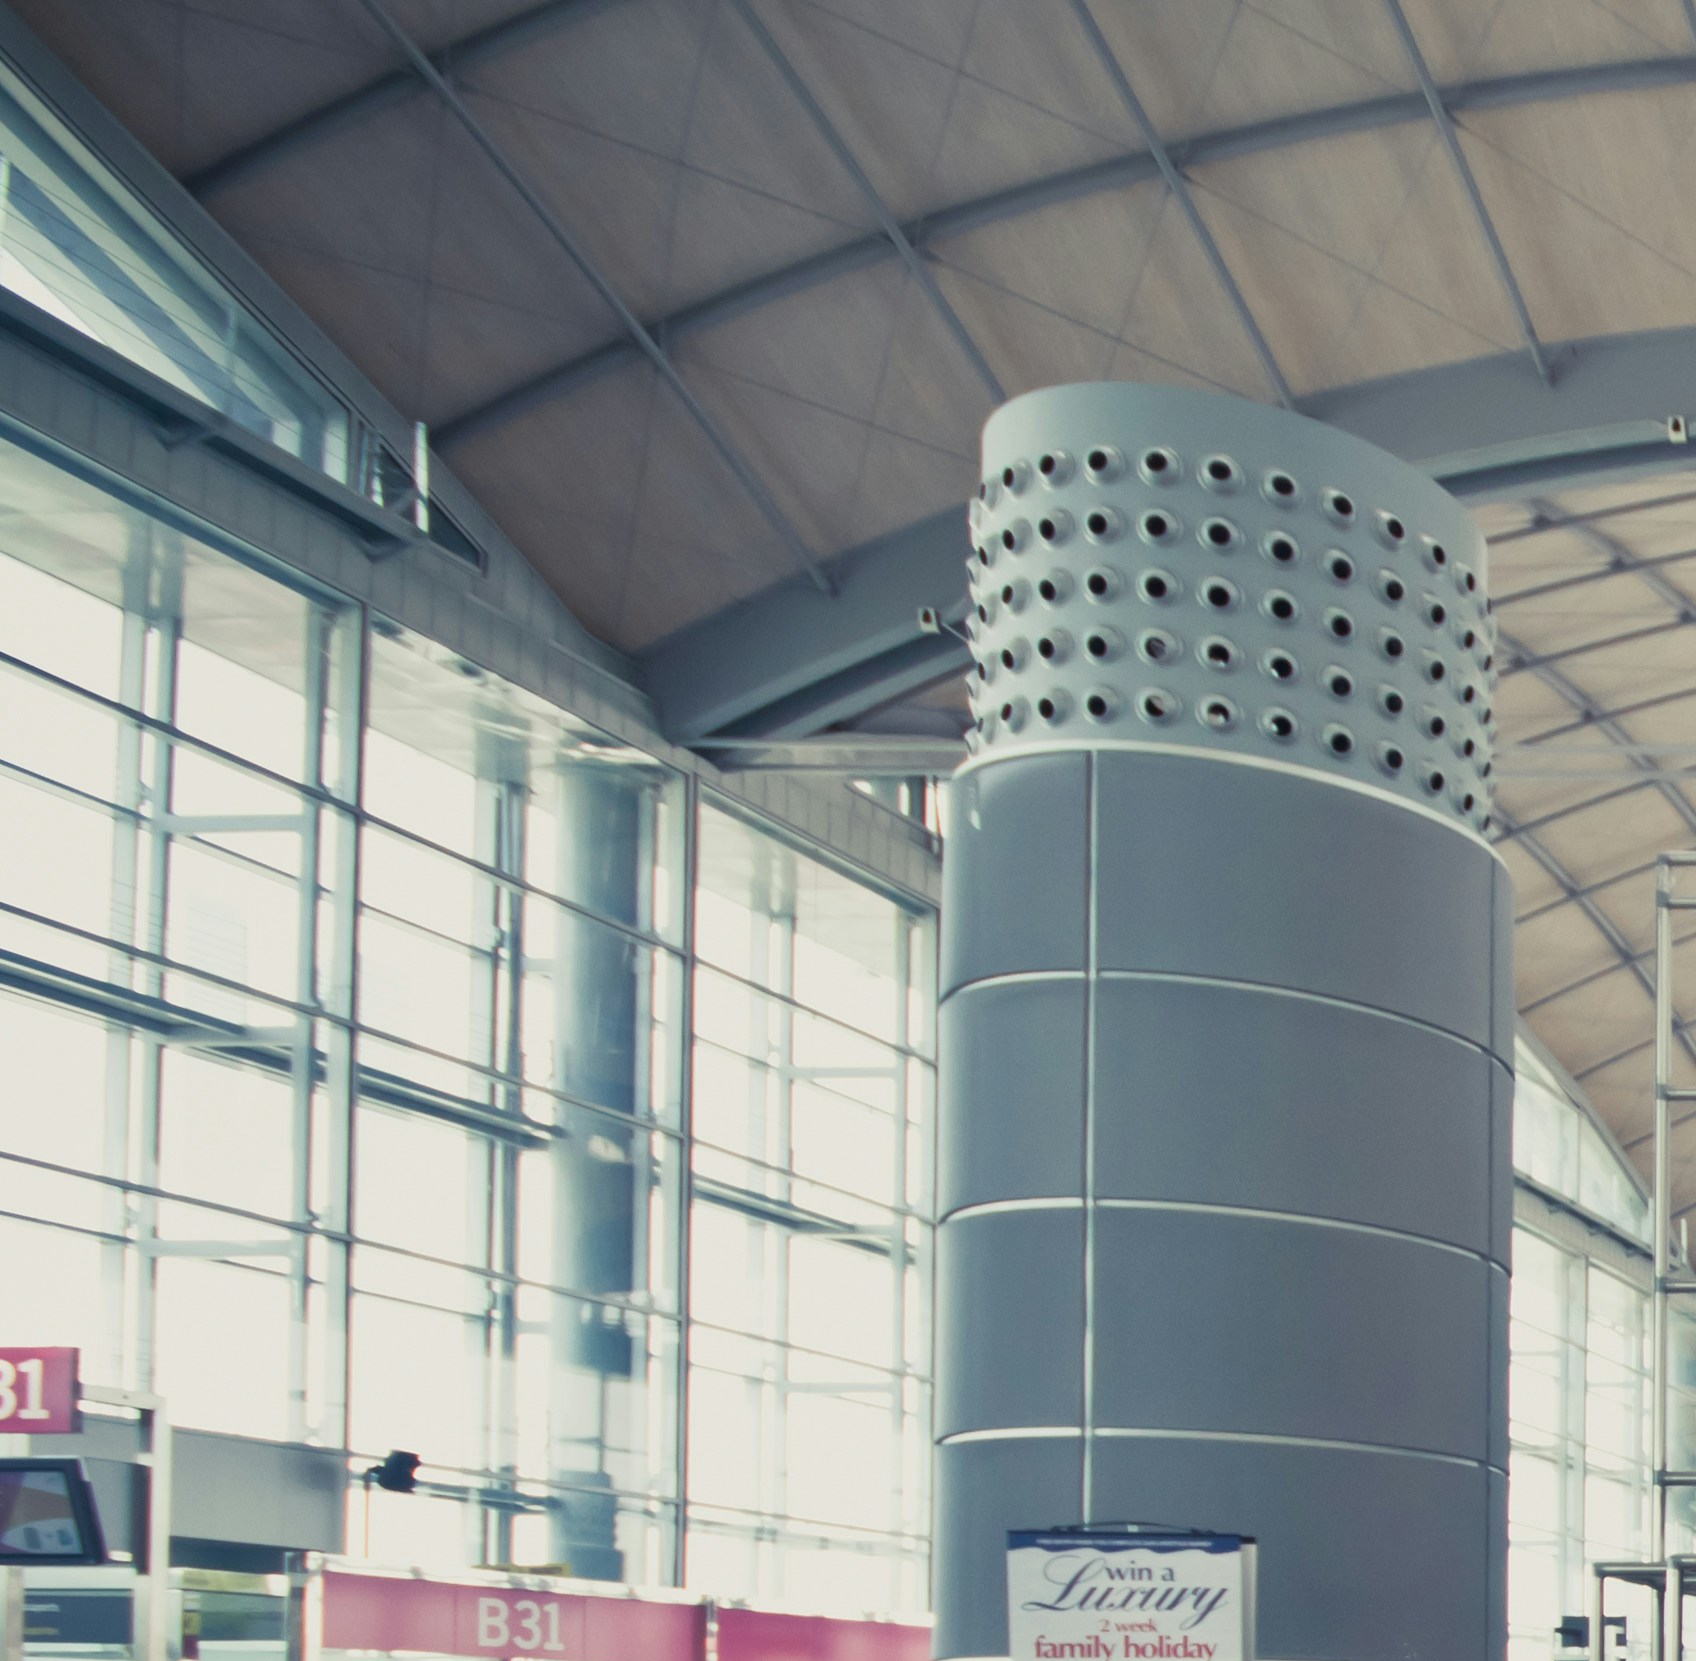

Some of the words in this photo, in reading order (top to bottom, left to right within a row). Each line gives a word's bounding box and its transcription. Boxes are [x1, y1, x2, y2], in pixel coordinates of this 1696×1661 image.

[1104, 1561, 1152, 1581] win
[1161, 1568, 1175, 1581] a
[1021, 1555, 1229, 1630] Luxury
[477, 1597, 565, 1651] B31
[1100, 1619, 1109, 1632] 2
[1115, 1618, 1157, 1632] week
